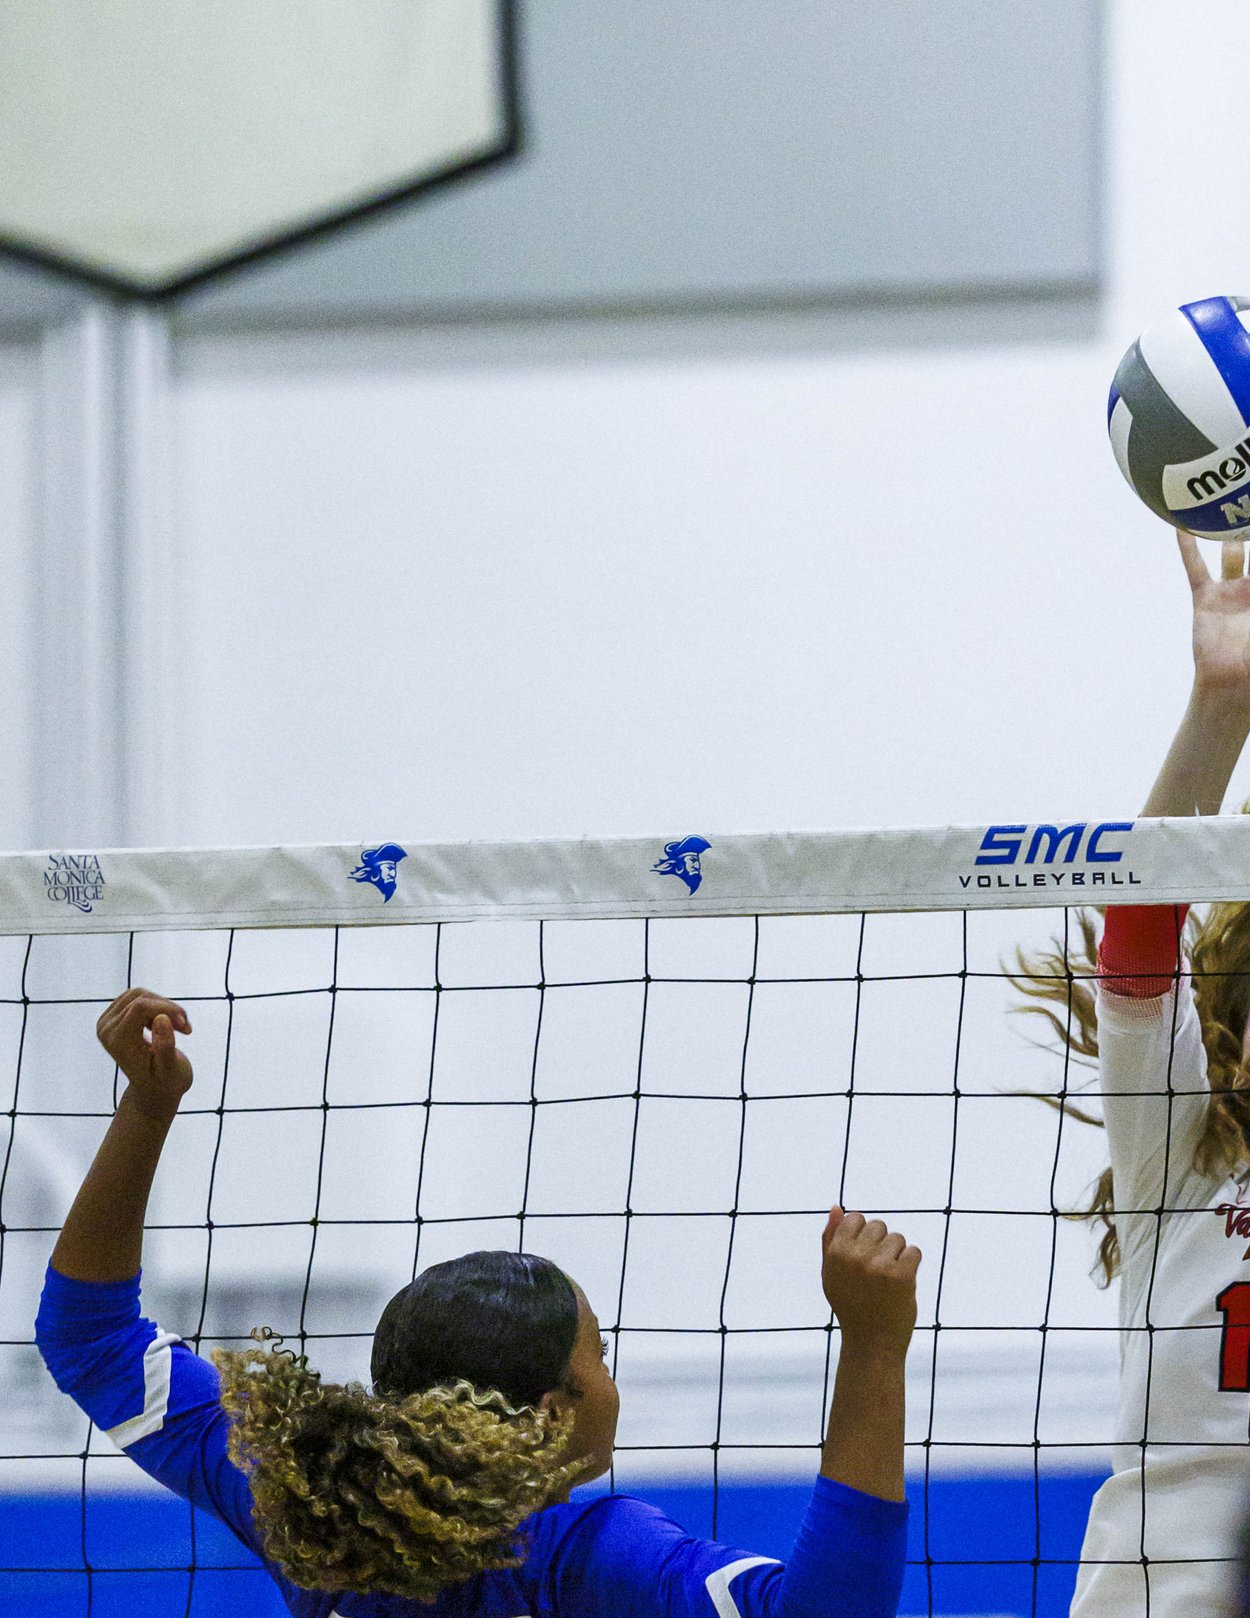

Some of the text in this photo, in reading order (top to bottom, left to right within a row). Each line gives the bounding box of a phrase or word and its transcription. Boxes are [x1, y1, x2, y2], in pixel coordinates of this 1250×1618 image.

[974, 821, 1135, 866] SMC
[47, 854, 101, 871] SANTA
[43, 869, 106, 886] MONICA
[958, 871, 1142, 889] VOLLEYBALL
[47, 884, 105, 914] COLLEGE
